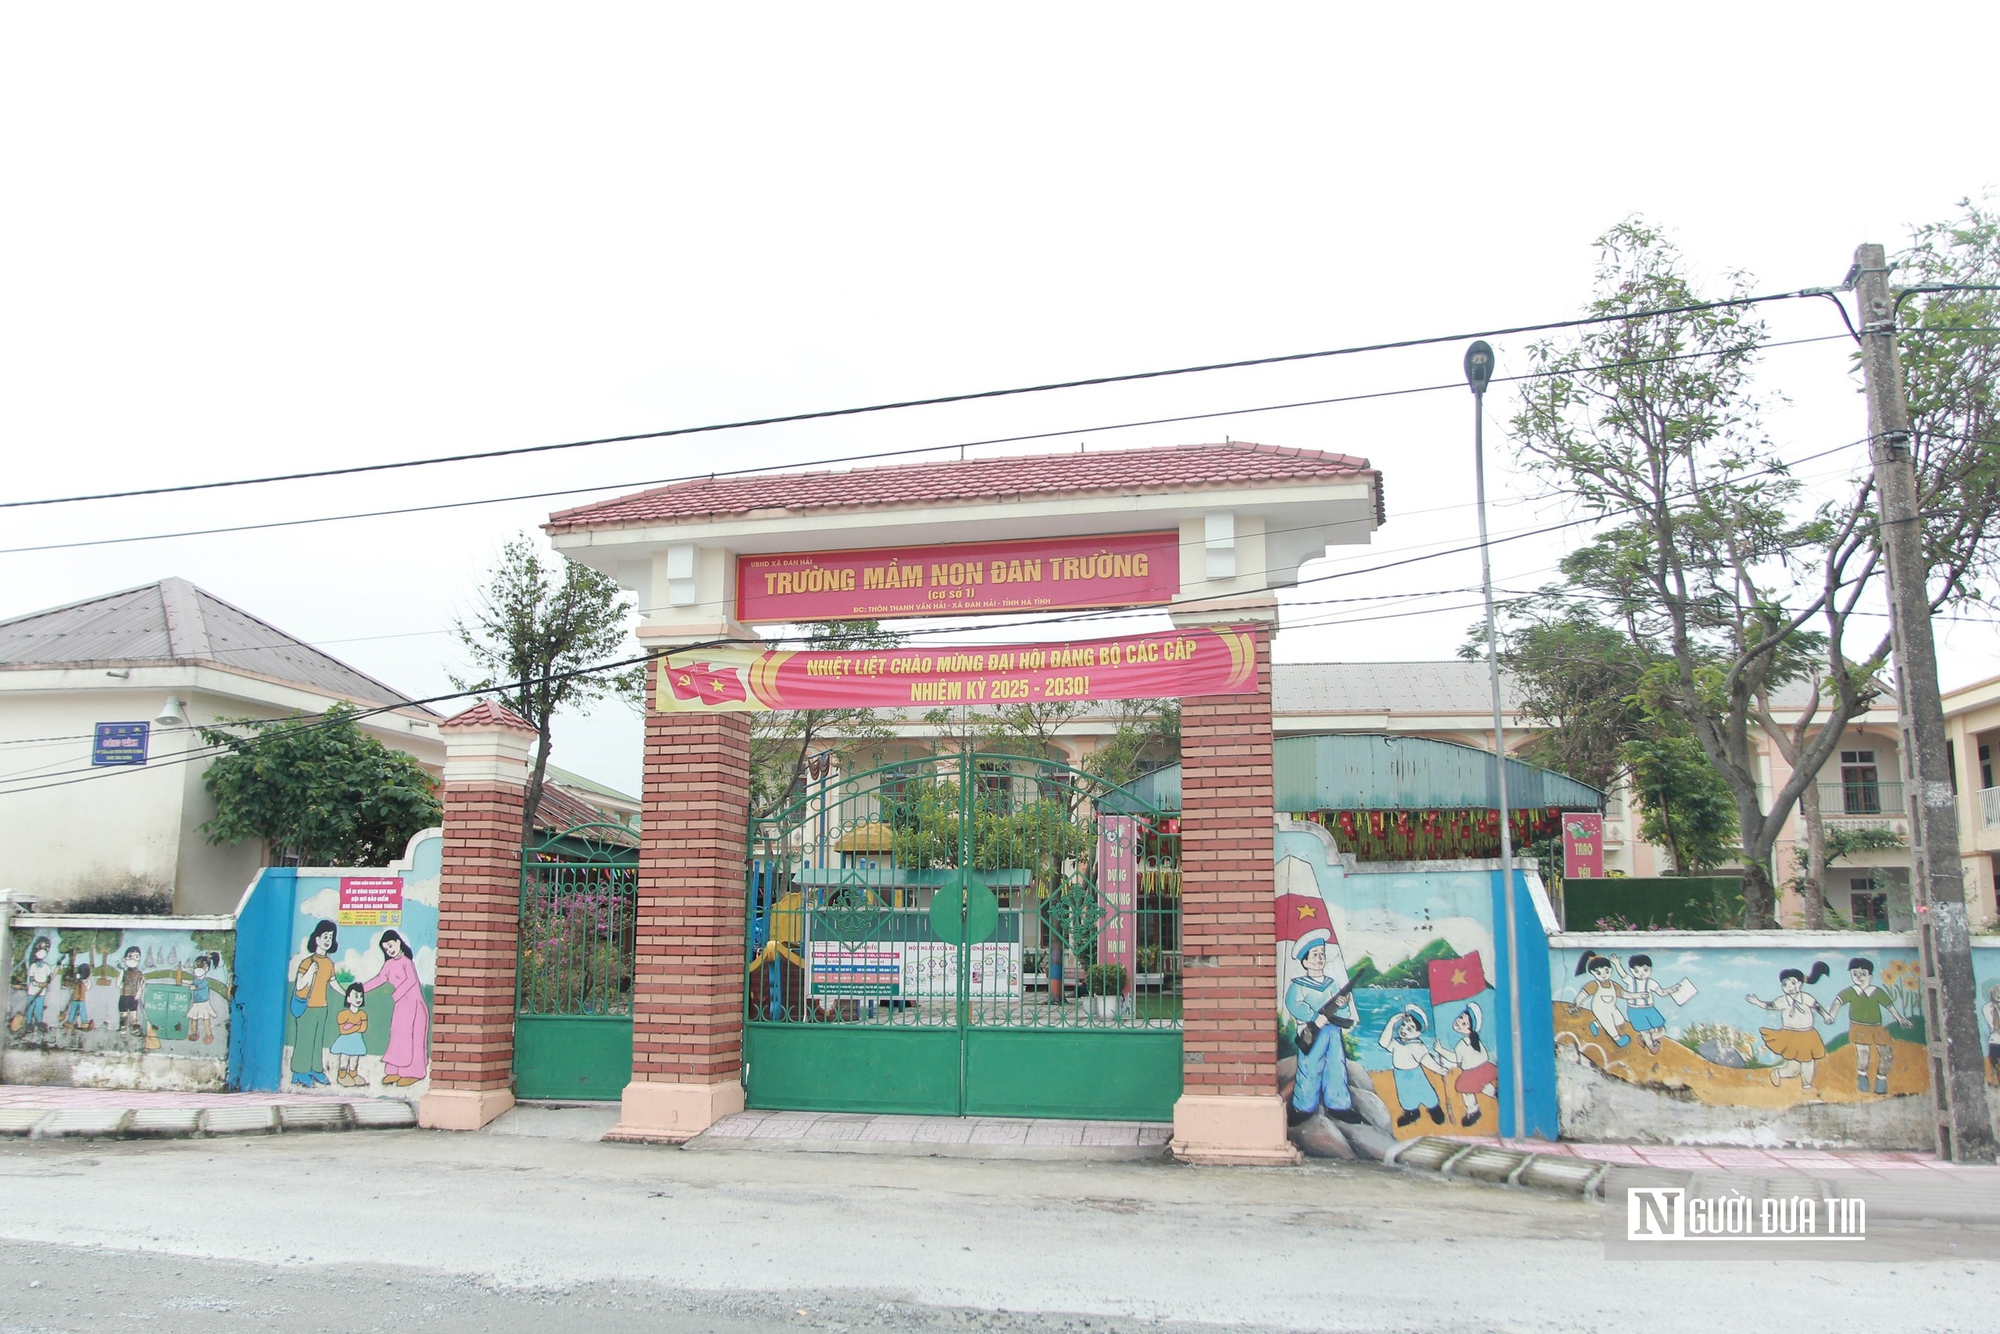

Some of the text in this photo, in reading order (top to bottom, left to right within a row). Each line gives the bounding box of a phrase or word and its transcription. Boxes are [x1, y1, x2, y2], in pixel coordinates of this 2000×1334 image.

[771, 559, 781, 567] XÃ
[800, 556, 813, 565] HẢI
[764, 549, 1149, 595] TRƯỜNG MẦM NON ĐAN TRƯỜNG
[965, 587, 976, 599] 1)
[853, 606, 867, 614] ĐC:
[868, 603, 888, 613] THÔN
[889, 603, 914, 612] THANH
[915, 602, 931, 611] VĂN
[933, 600, 947, 609] HẢI
[952, 601, 963, 609] XÃ
[983, 598, 997, 607] HẢI
[1002, 597, 1019, 606] TỈNH
[1021, 597, 1032, 605] HÀ
[1034, 597, 1051, 605] TĨNH
[806, 633, 1197, 679] NHIỆT LIỆT CHÀO MỪNG ĐẠI HỘI ĐẢNG BỘ CÁC CẤP
[910, 678, 962, 705] NHIỆM
[966, 677, 987, 700] KỲ
[991, 678, 1029, 699] 2025
[1045, 675, 1090, 698] 2030!
[1574, 842, 1593, 856] TRAO
